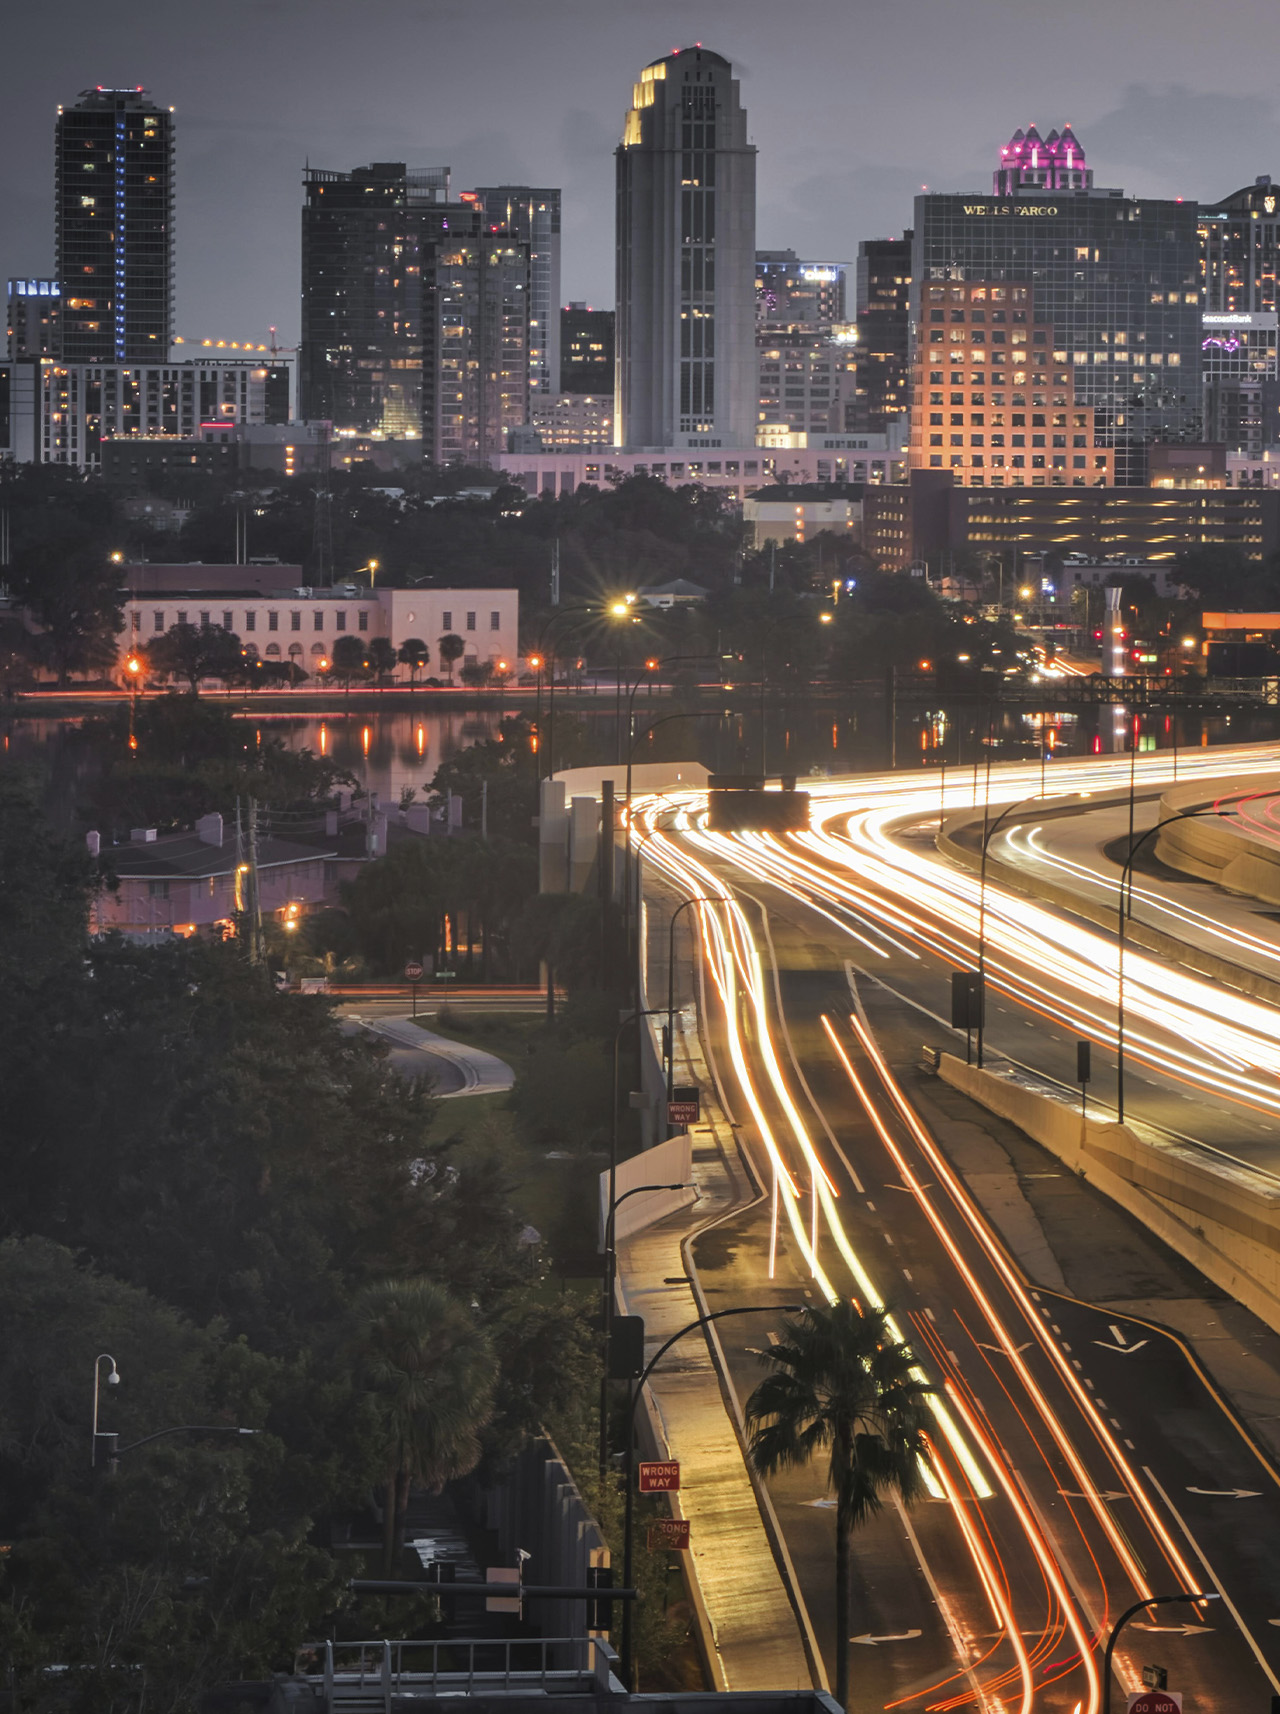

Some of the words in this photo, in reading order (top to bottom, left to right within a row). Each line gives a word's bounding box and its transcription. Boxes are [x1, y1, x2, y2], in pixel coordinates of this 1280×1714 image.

[963, 205, 1010, 215] WELLS
[1014, 206, 1058, 216] FARGO
[407, 967, 422, 975] STOP
[674, 1113, 690, 1121] WAY
[642, 1466, 678, 1476] WRONG
[649, 1478, 670, 1487] WAY
[661, 1523, 688, 1534] RONG
[1135, 1703, 1149, 1713] DO
[1155, 1703, 1174, 1712] NOT
